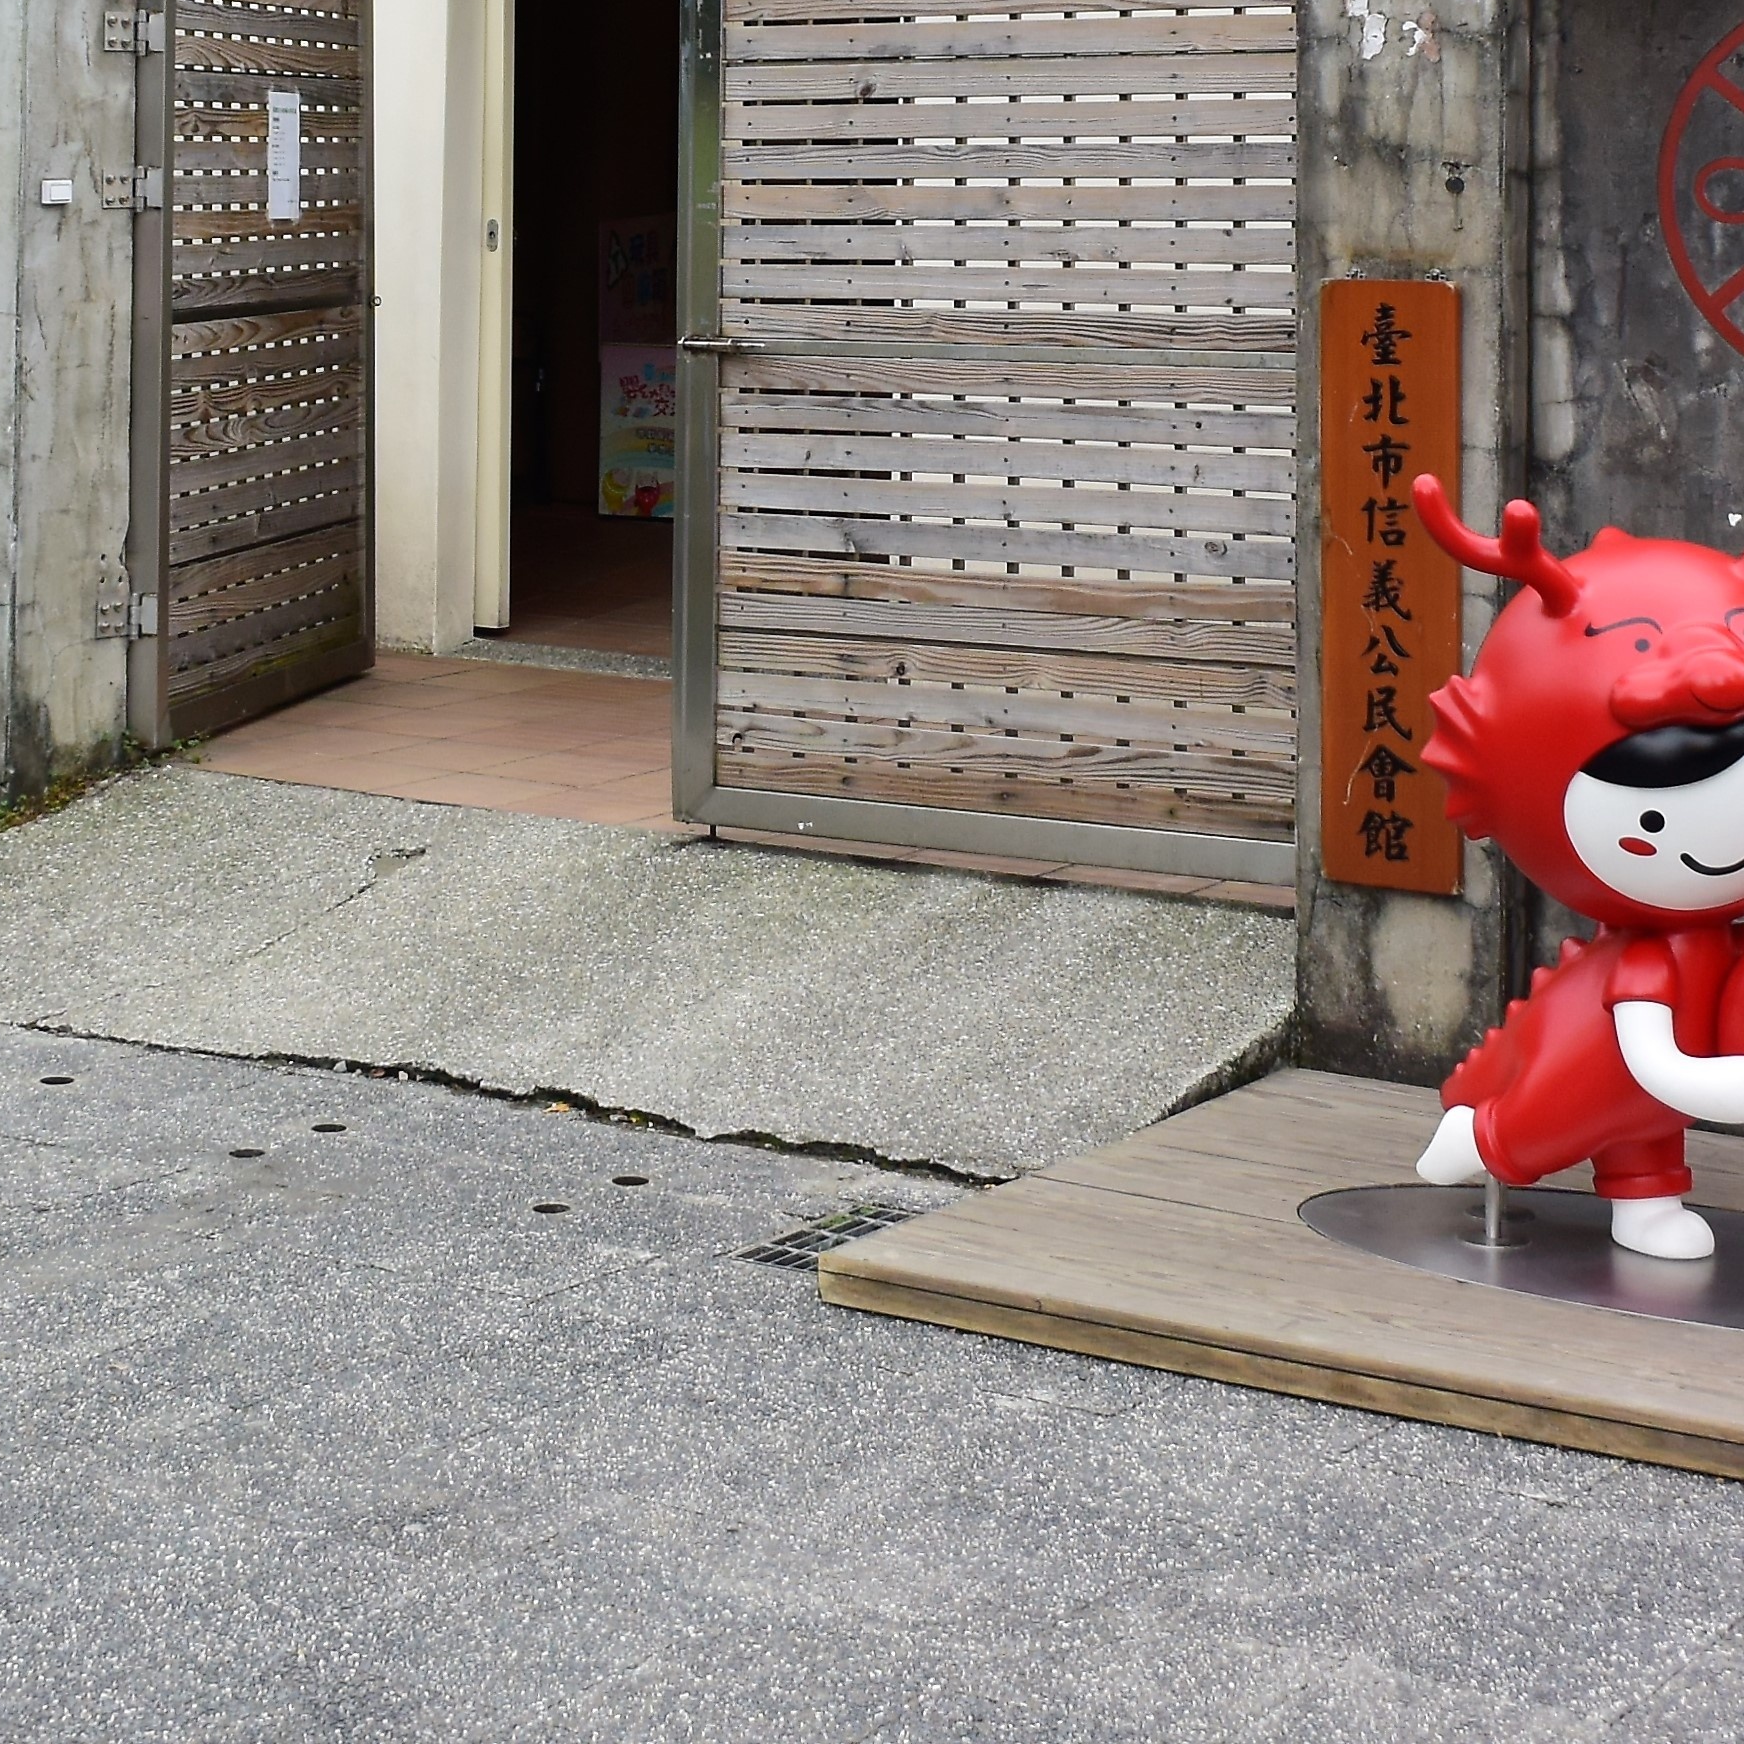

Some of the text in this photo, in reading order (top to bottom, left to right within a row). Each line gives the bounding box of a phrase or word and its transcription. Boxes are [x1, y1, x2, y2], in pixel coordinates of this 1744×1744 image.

[1358, 302, 1417, 862] 臺北市信義公民會館
